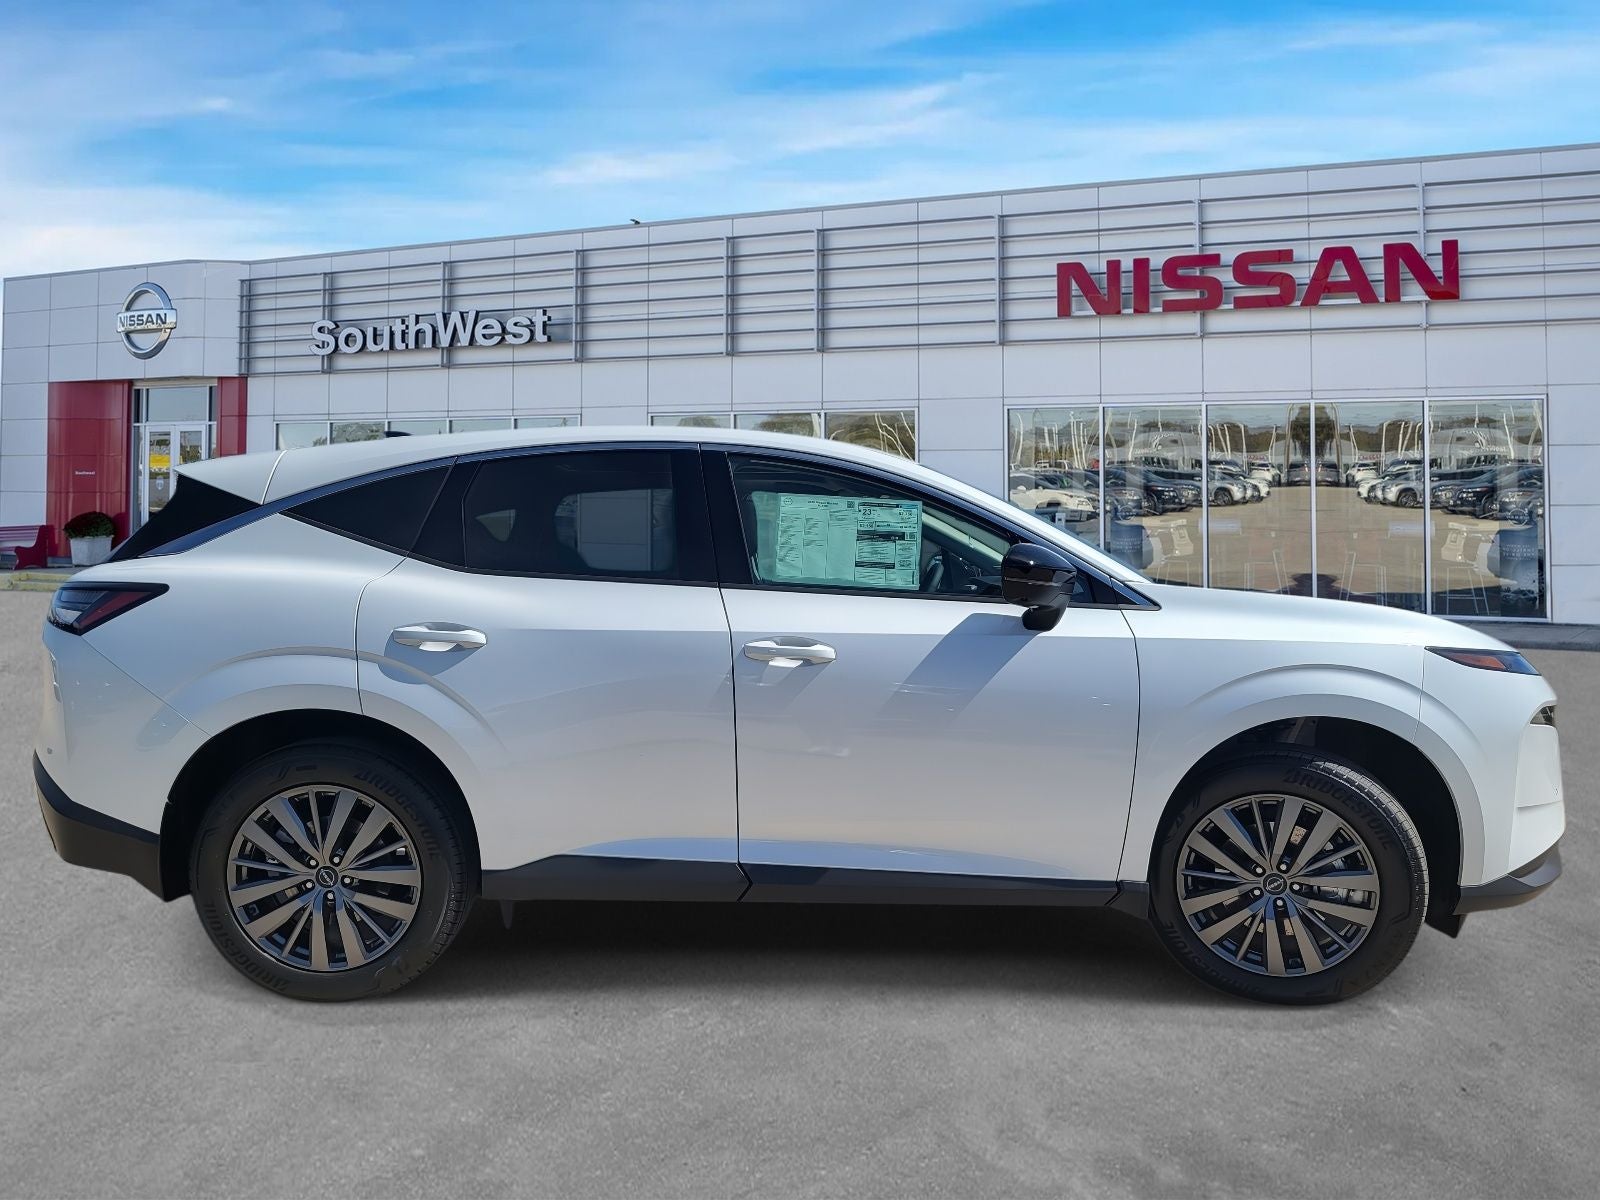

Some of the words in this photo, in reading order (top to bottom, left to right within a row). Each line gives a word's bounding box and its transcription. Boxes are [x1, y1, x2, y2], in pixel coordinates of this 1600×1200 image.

[1056, 239, 1461, 318] NISSAN
[119, 312, 167, 328] NISSAN
[309, 308, 552, 356] SouthWest
[862, 508, 872, 516] 23
[353, 766, 442, 860] BRIDGESTONE
[1283, 767, 1397, 852] BRIDGESTONE
